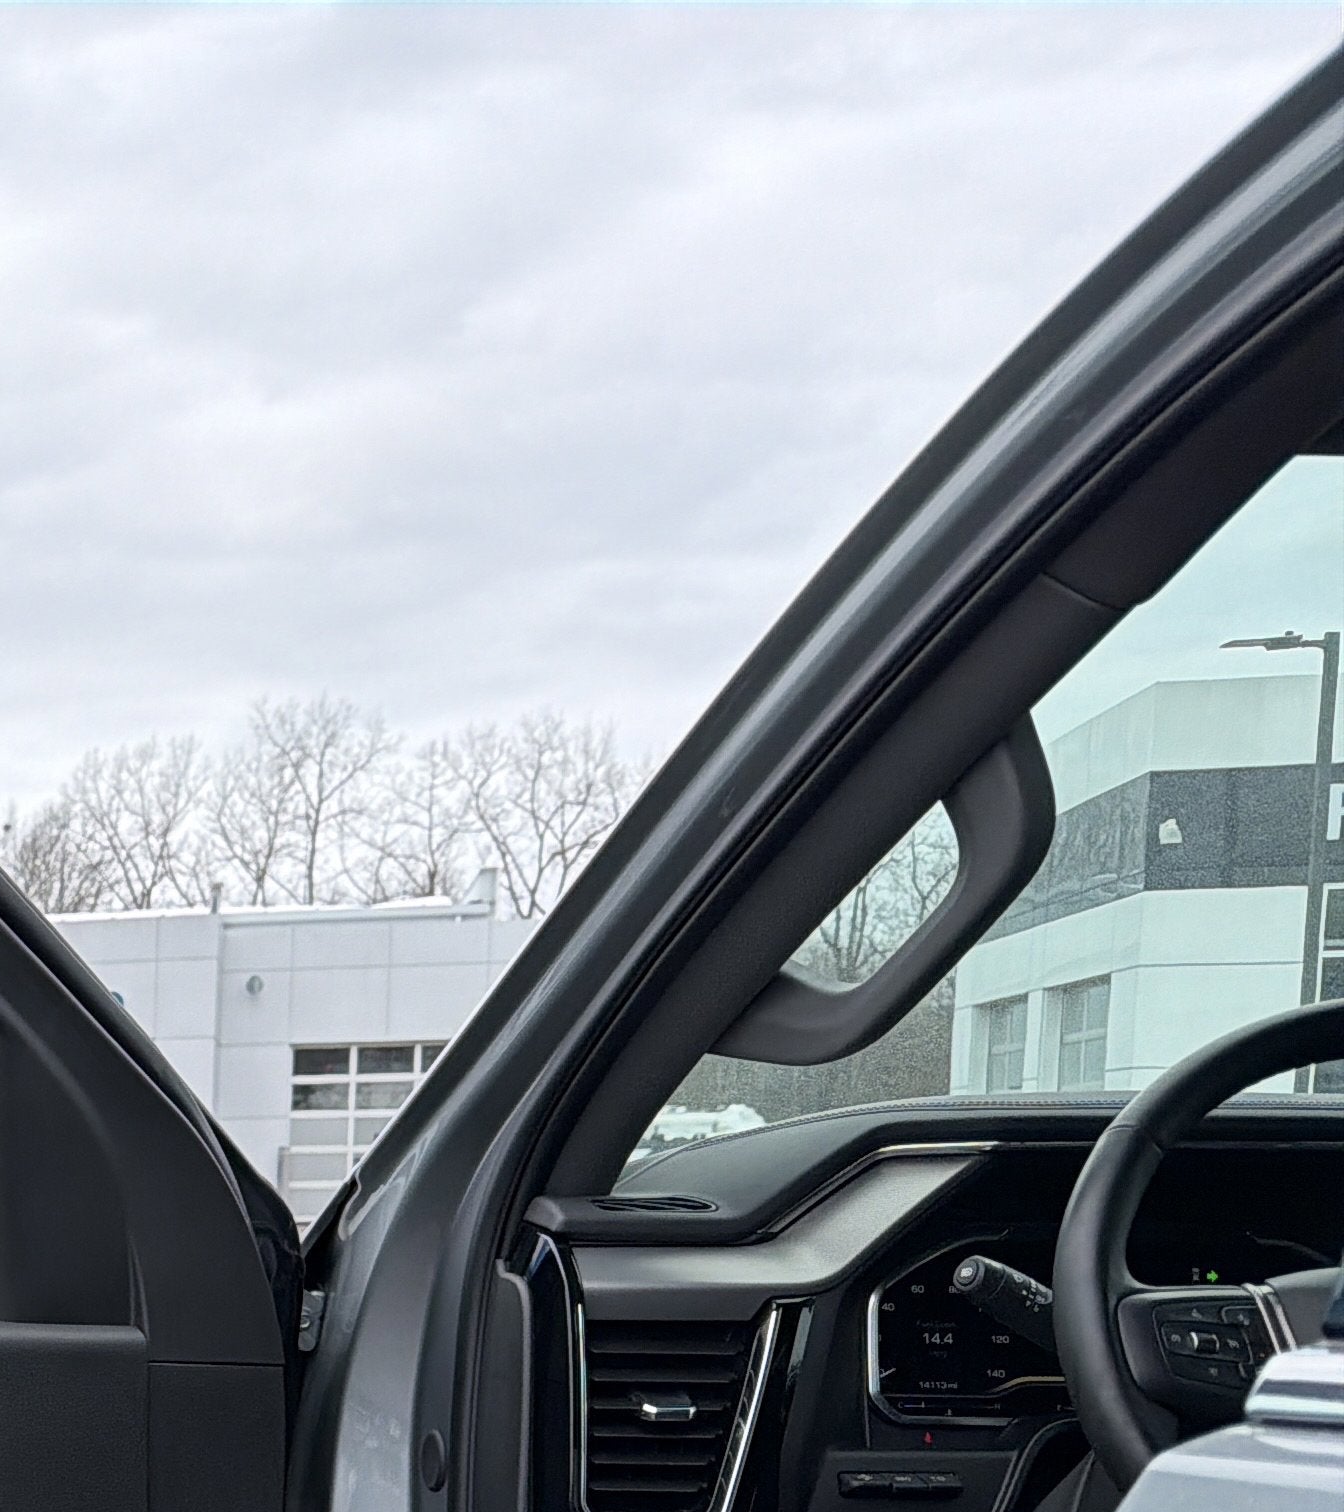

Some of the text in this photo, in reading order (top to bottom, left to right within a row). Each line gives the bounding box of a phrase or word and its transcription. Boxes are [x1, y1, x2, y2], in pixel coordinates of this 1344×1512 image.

[911, 1285, 924, 1293] 60
[882, 1303, 895, 1311] 40
[922, 1333, 953, 1345] 14.4
[991, 1335, 1010, 1344] 120
[987, 1369, 1006, 1378] 140
